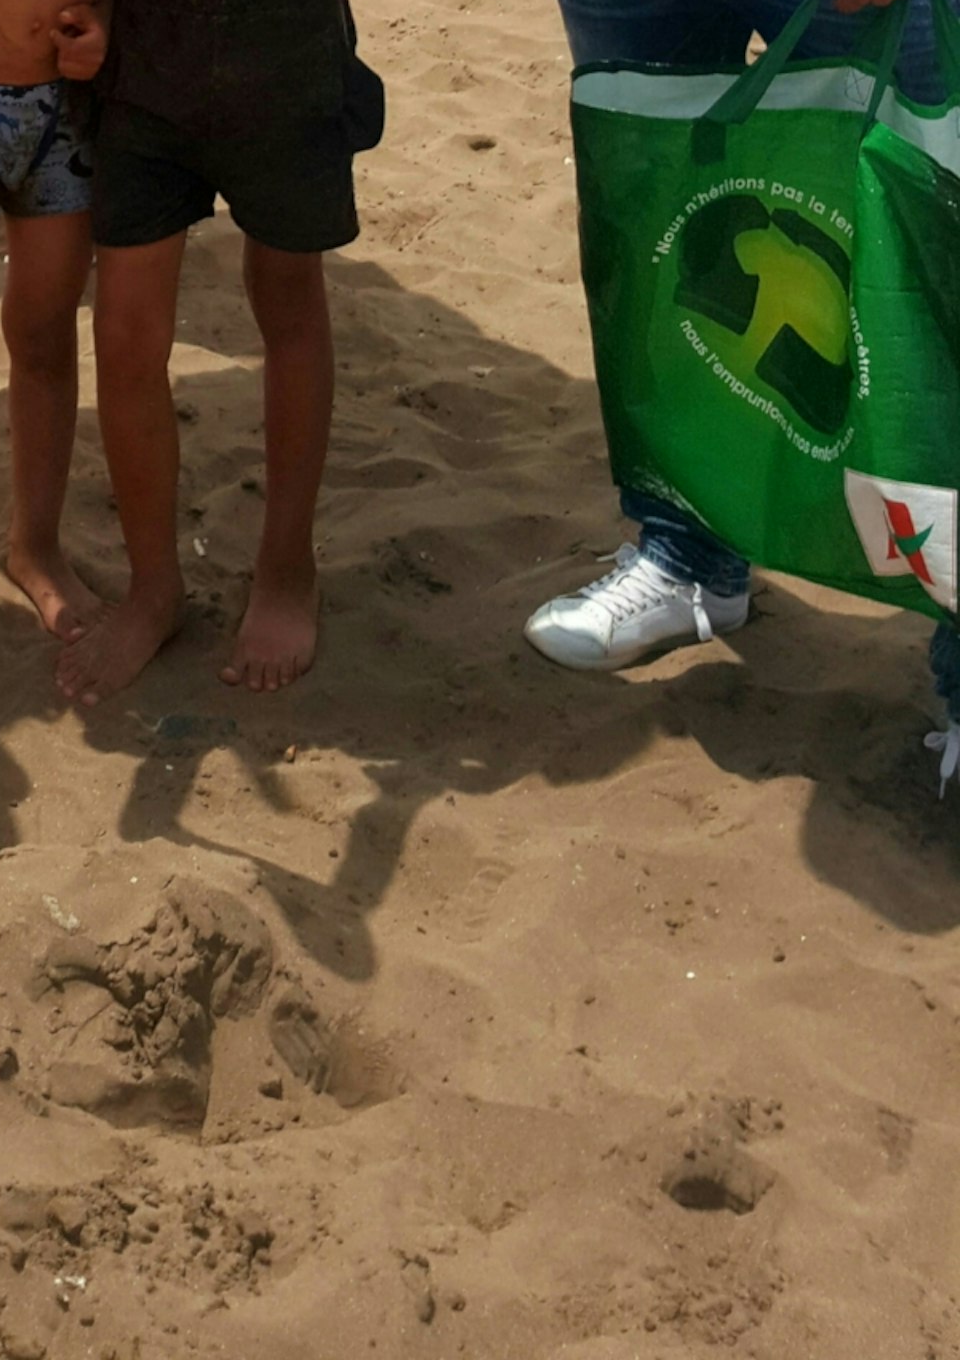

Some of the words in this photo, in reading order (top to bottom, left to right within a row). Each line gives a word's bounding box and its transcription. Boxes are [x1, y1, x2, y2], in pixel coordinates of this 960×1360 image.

[685, 178, 766, 215] n'héritons
[770, 182, 804, 204] pas
[808, 195, 826, 215] la
[680, 320, 709, 357] nous
[792, 432, 811, 454] nos
